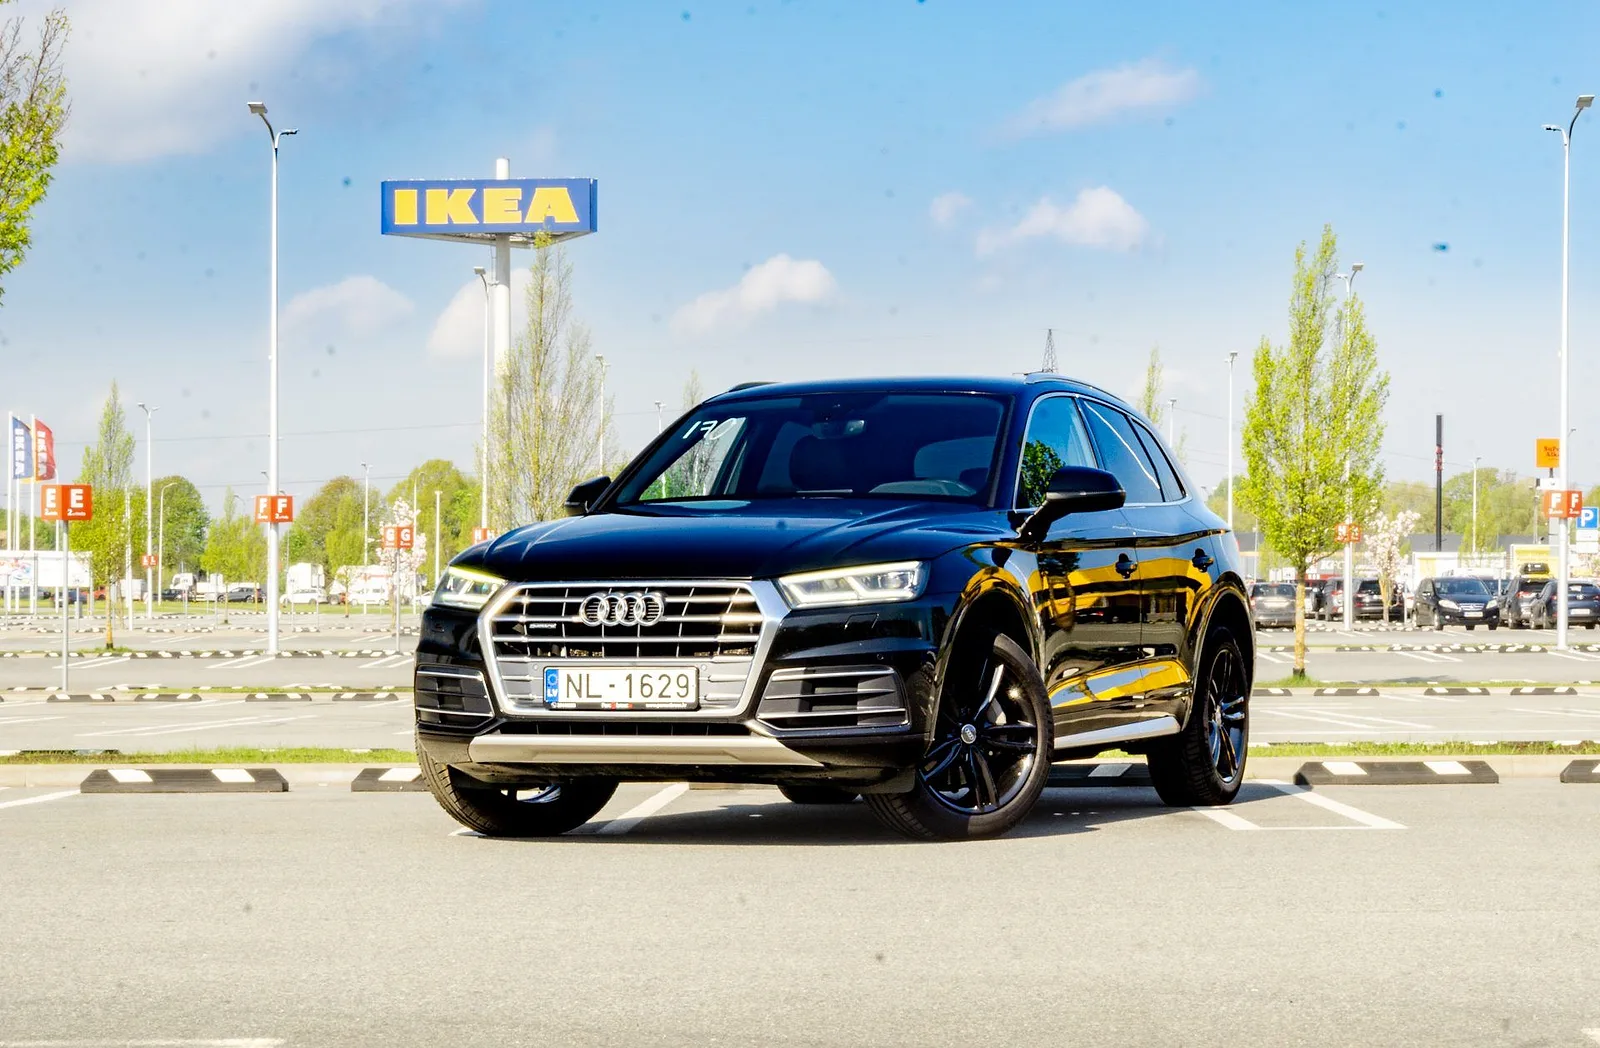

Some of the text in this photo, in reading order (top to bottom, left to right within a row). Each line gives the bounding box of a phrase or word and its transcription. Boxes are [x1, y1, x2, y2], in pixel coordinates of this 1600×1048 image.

[394, 187, 580, 225] IKEA
[14, 428, 25, 476] IKEA
[46, 488, 56, 508] E
[70, 488, 84, 508] E
[259, 497, 267, 513] F
[277, 498, 287, 513] F
[1551, 492, 1562, 508] F
[1571, 493, 1579, 508] F
[1581, 509, 1594, 527] P
[401, 528, 411, 541] G
[547, 688, 558, 697] LV
[566, 673, 690, 698] NL-1629
